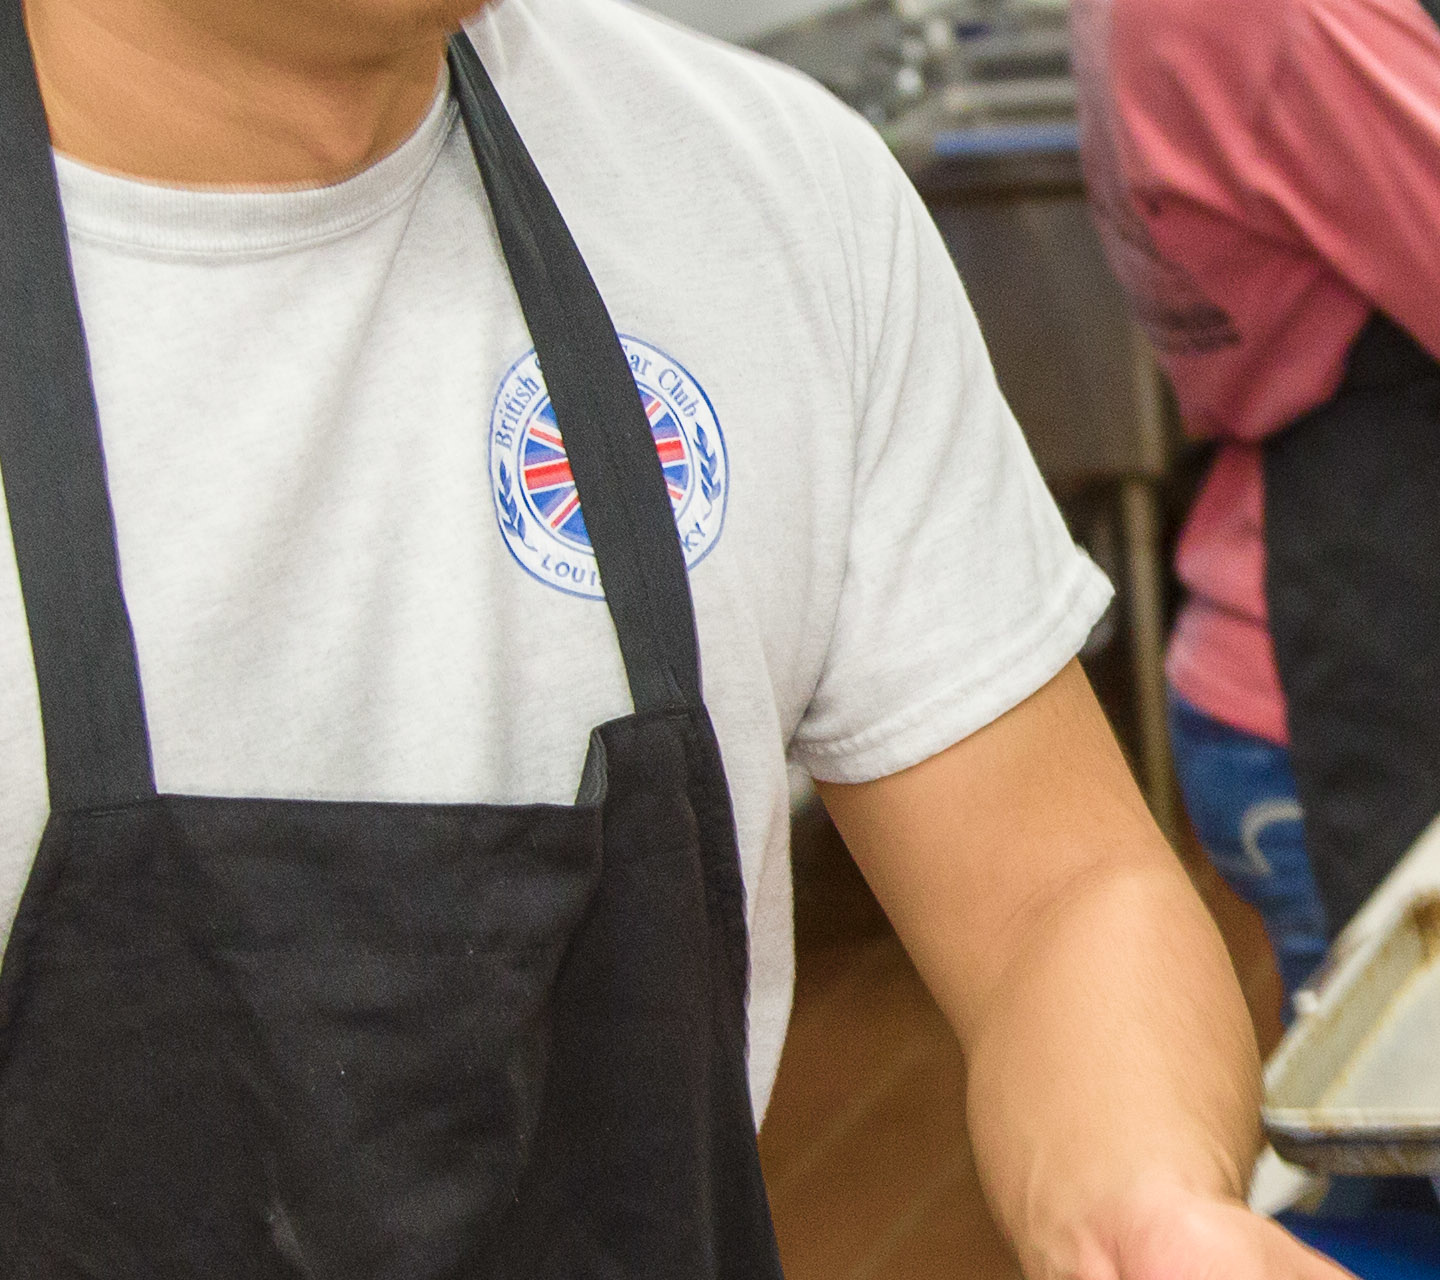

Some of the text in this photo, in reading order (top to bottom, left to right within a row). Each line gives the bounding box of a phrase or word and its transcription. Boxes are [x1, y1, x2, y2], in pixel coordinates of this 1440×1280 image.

[495, 344, 700, 450] British ar Club
[541, 520, 706, 587] LOUI KY
